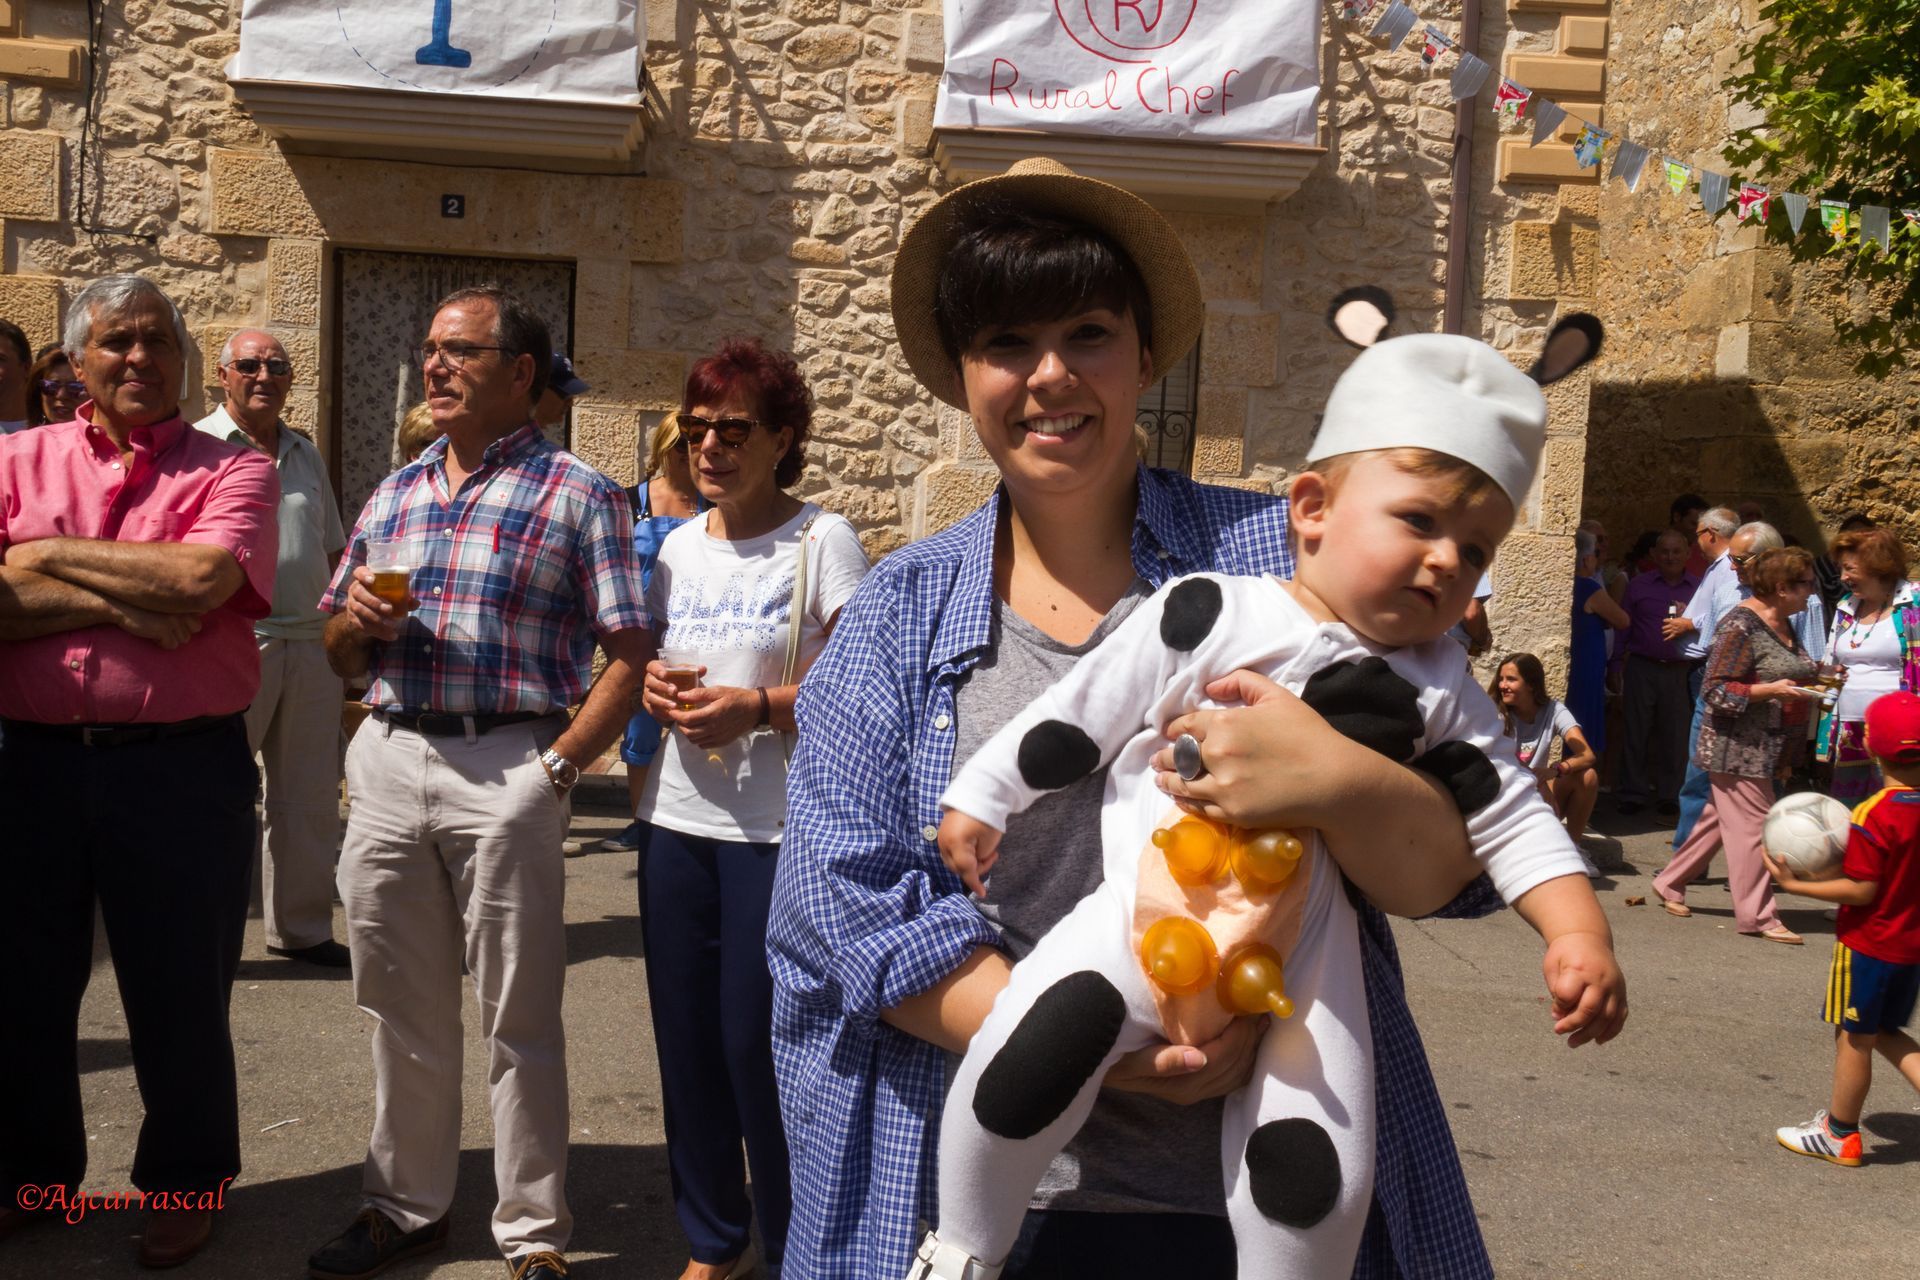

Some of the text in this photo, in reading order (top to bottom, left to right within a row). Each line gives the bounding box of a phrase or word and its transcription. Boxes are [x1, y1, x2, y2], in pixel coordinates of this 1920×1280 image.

[988, 57, 1240, 117] Rural Chef
[446, 198, 460, 215] 2
